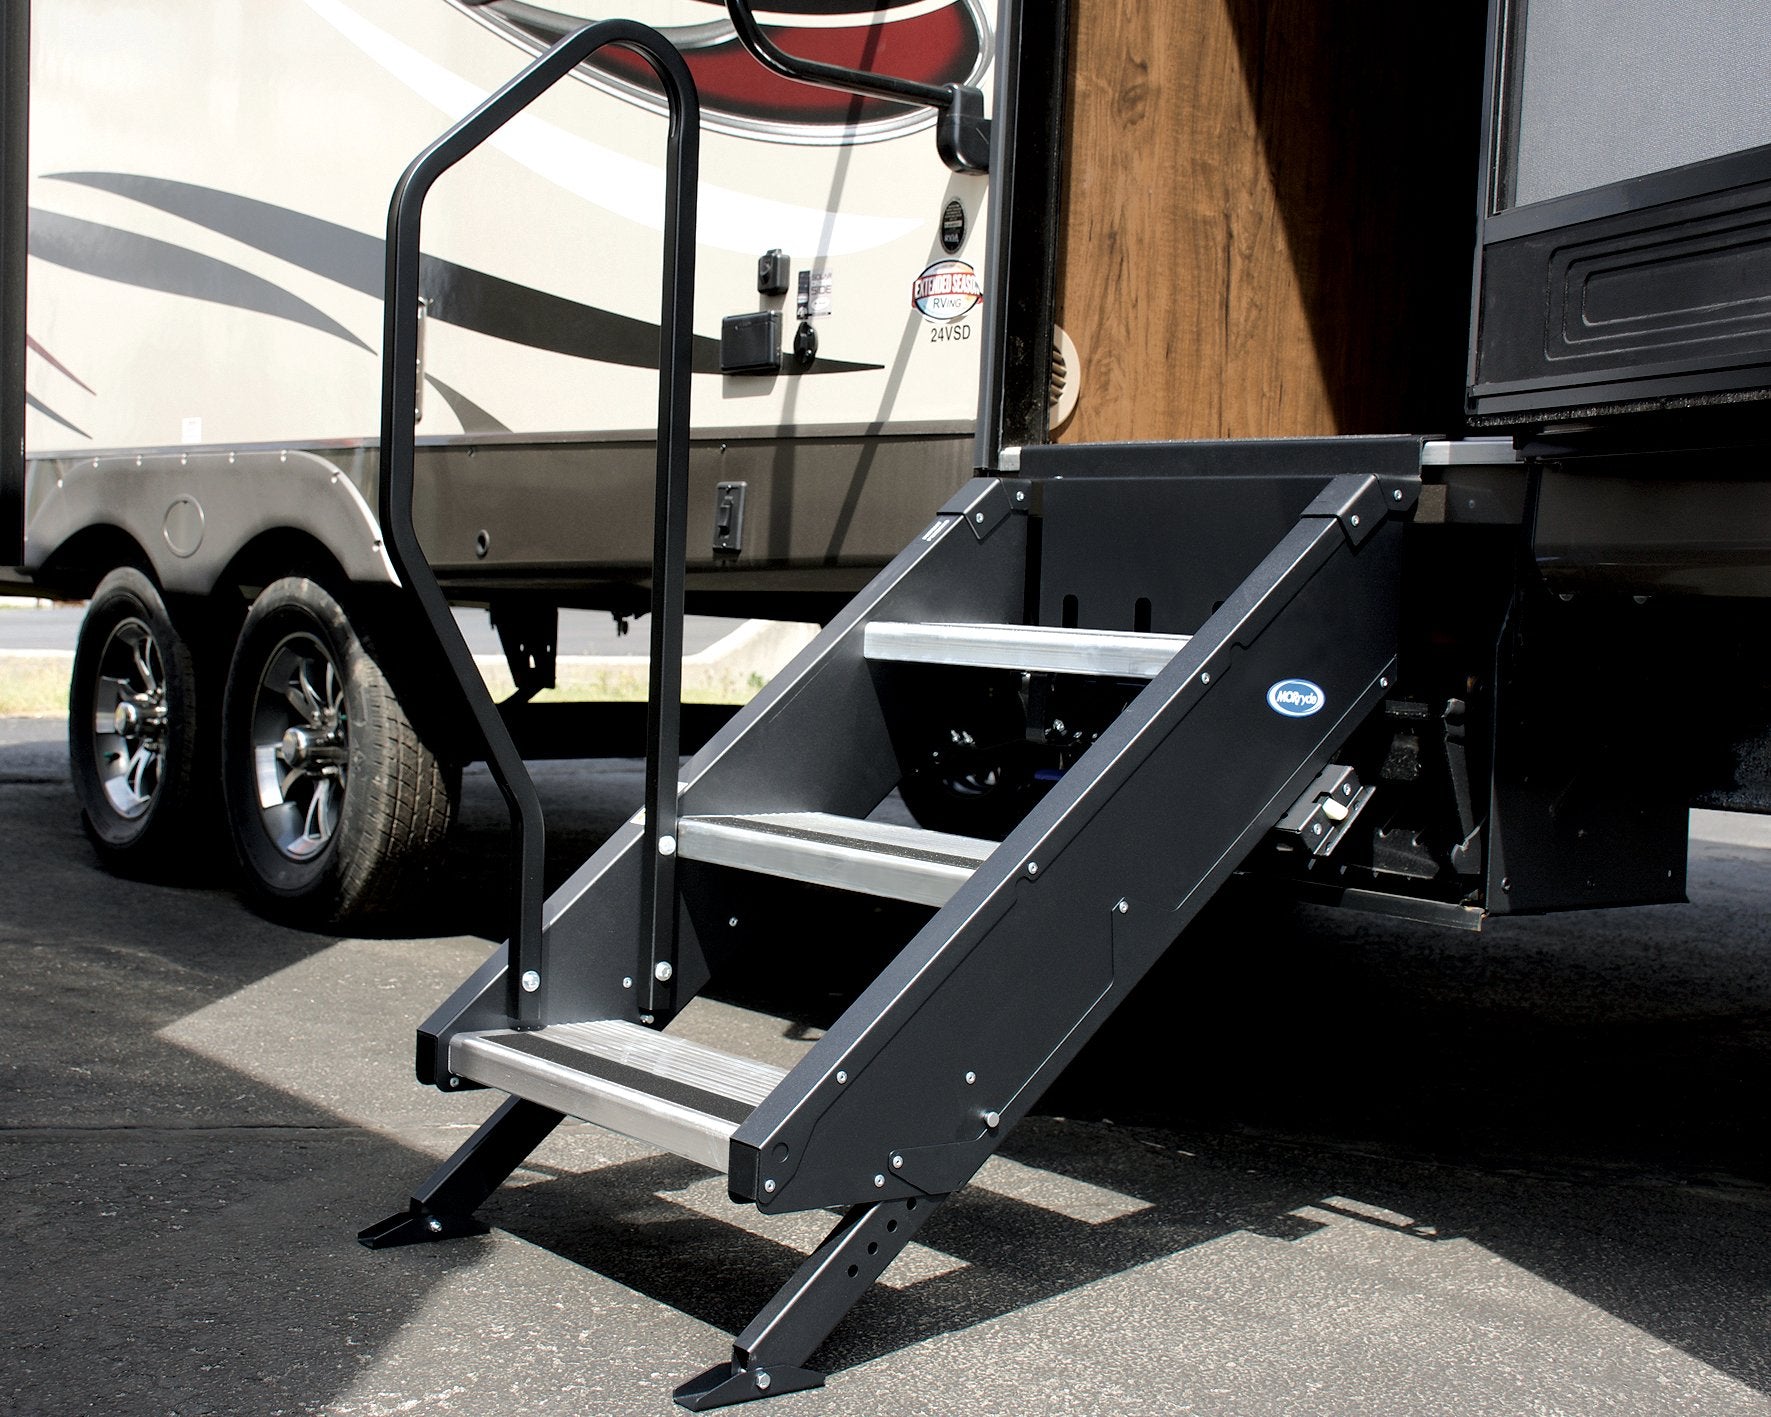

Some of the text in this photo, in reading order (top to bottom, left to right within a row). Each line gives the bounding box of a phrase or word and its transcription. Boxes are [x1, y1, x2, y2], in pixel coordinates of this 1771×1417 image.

[811, 285, 831, 295] SIDE
[914, 273, 951, 299] EXTENDED
[931, 324, 971, 342] 24VSD
